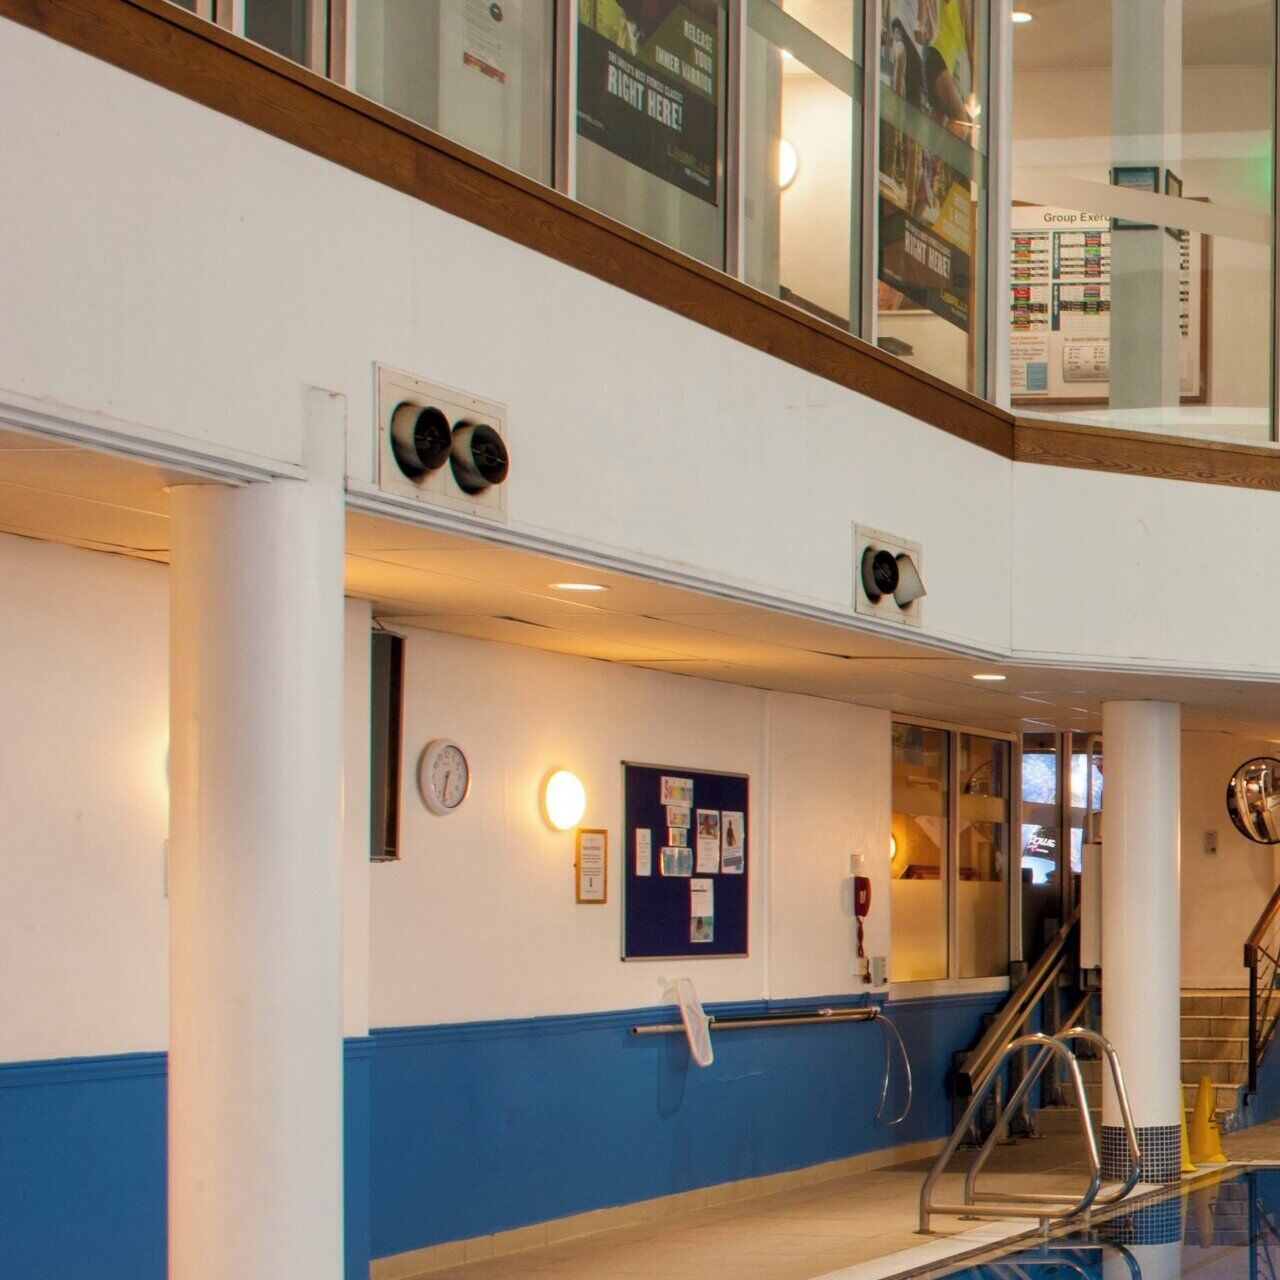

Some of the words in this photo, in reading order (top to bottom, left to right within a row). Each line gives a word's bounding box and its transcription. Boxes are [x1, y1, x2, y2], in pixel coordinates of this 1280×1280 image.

[684, 20, 713, 53] RELEASE
[656, 46, 680, 75] INNER
[682, 61, 712, 95] WARRIOR
[695, 48, 712, 74] YOUR
[608, 64, 644, 111] RIGHT
[648, 89, 683, 132] HERE!
[1044, 213, 1077, 223] Group
[905, 230, 926, 265] RIGHT
[928, 246, 950, 280] HERE!
